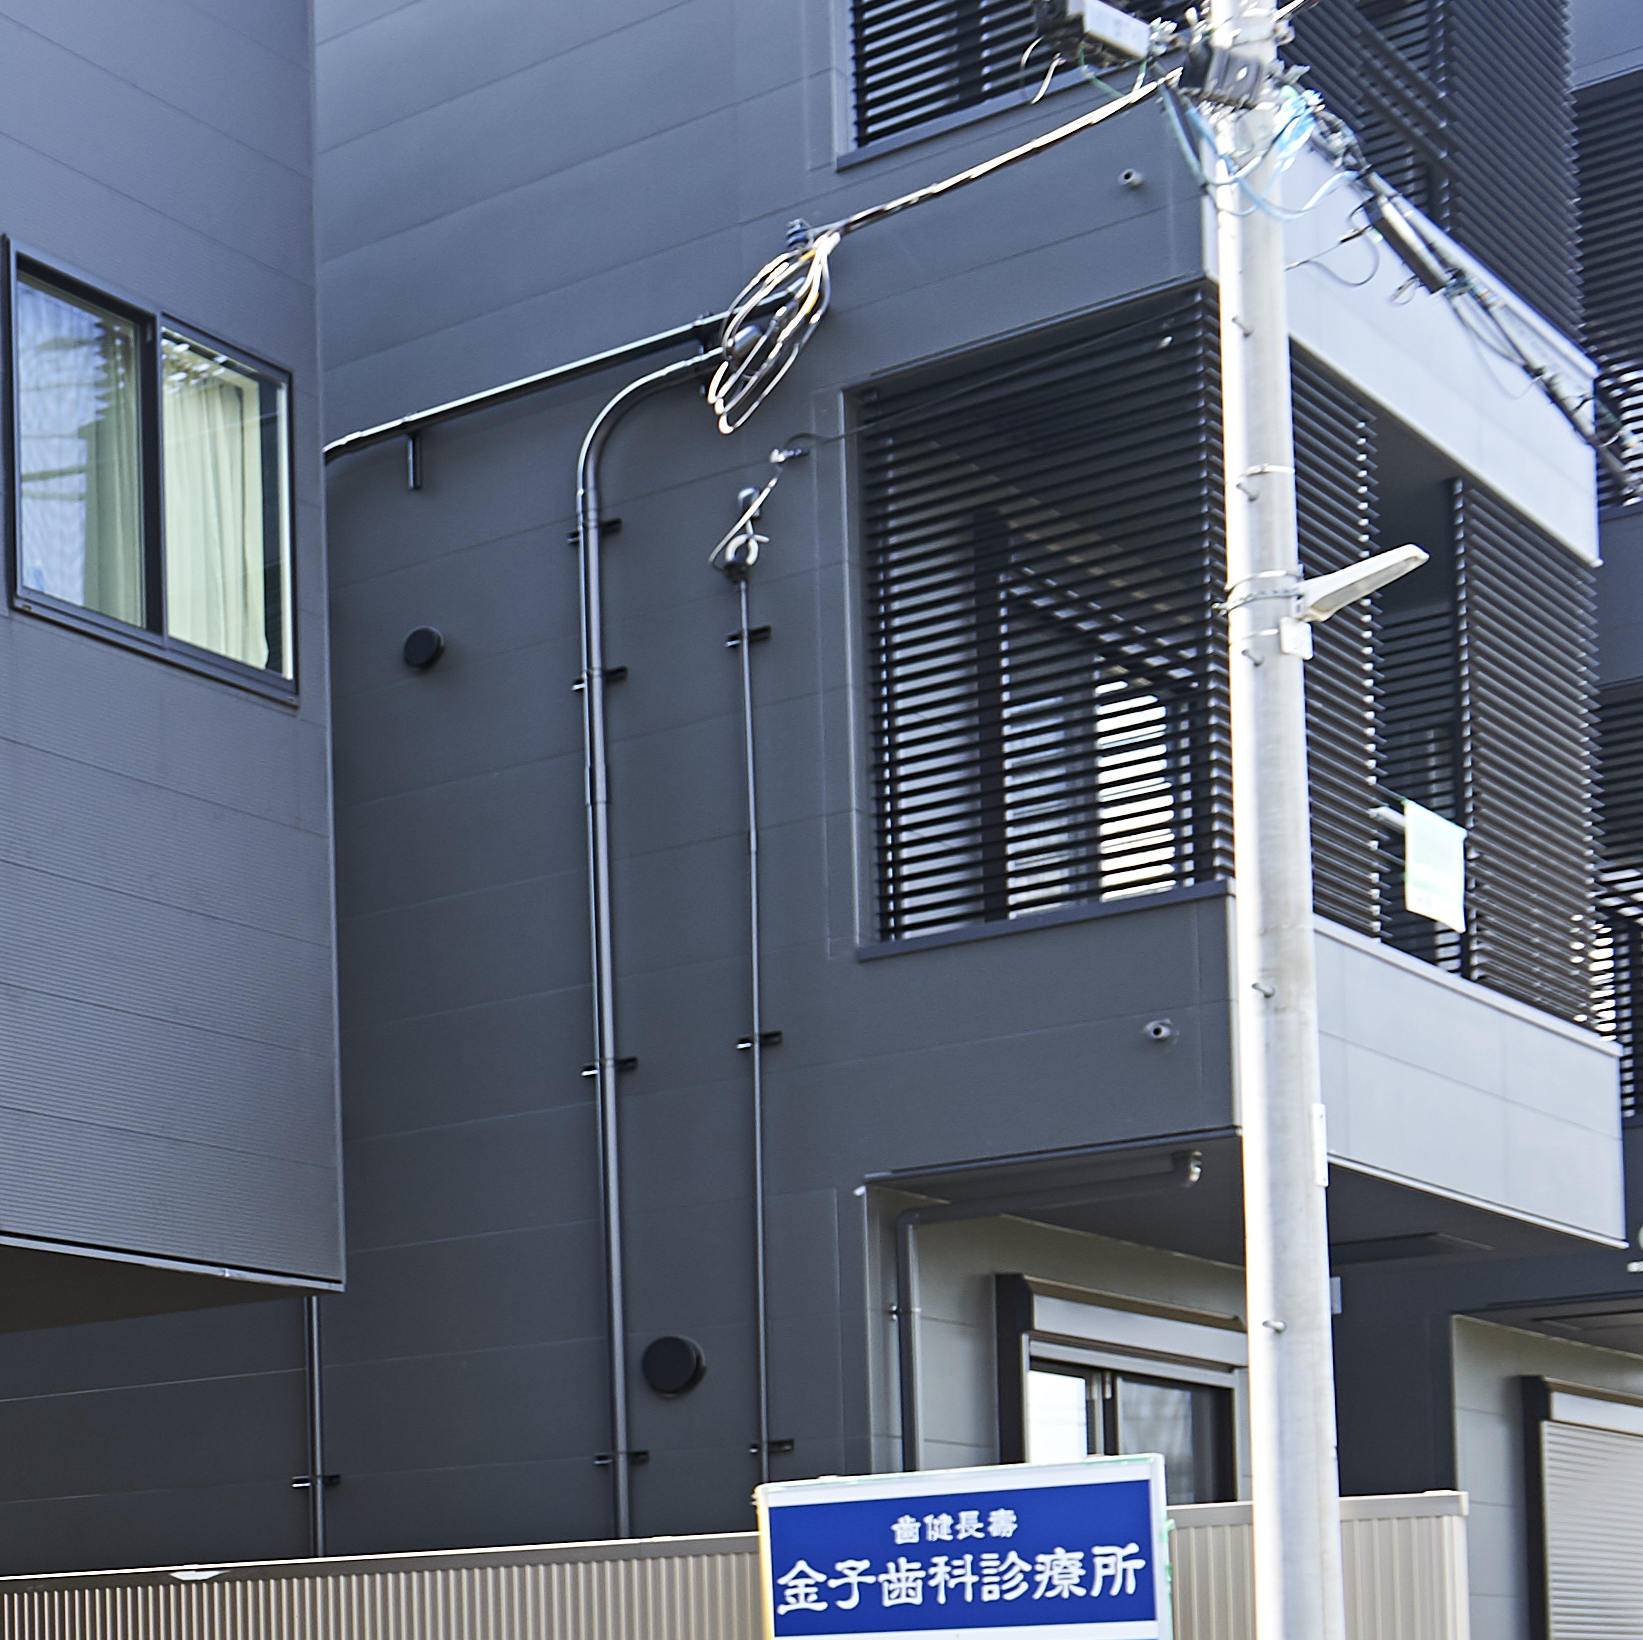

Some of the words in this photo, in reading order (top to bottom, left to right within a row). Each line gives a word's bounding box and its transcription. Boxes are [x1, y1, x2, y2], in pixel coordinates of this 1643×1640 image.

[776, 1541, 1147, 1616] 金子歯科診療所
